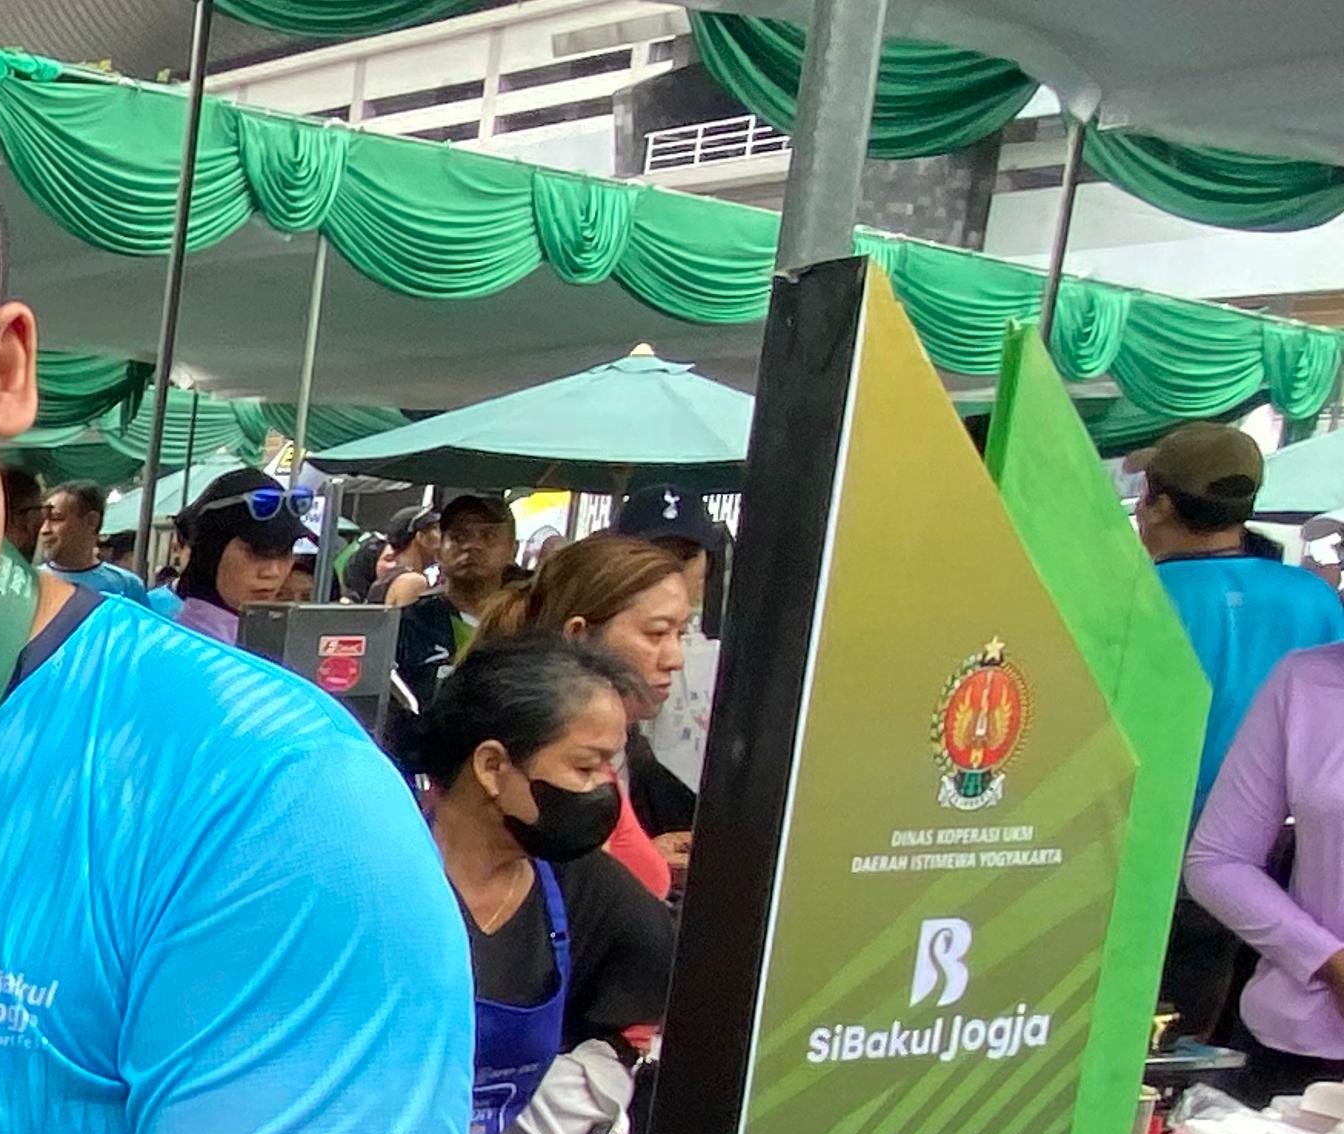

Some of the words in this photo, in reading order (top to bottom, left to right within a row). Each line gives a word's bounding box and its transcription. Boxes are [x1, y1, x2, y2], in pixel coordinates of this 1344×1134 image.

[891, 830, 933, 847] DINAS
[936, 828, 1001, 845] KOPERASI
[851, 854, 908, 873] DAERAH
[911, 852, 977, 869] ISTIMEWA
[979, 848, 1062, 868] YOGYAKARTA
